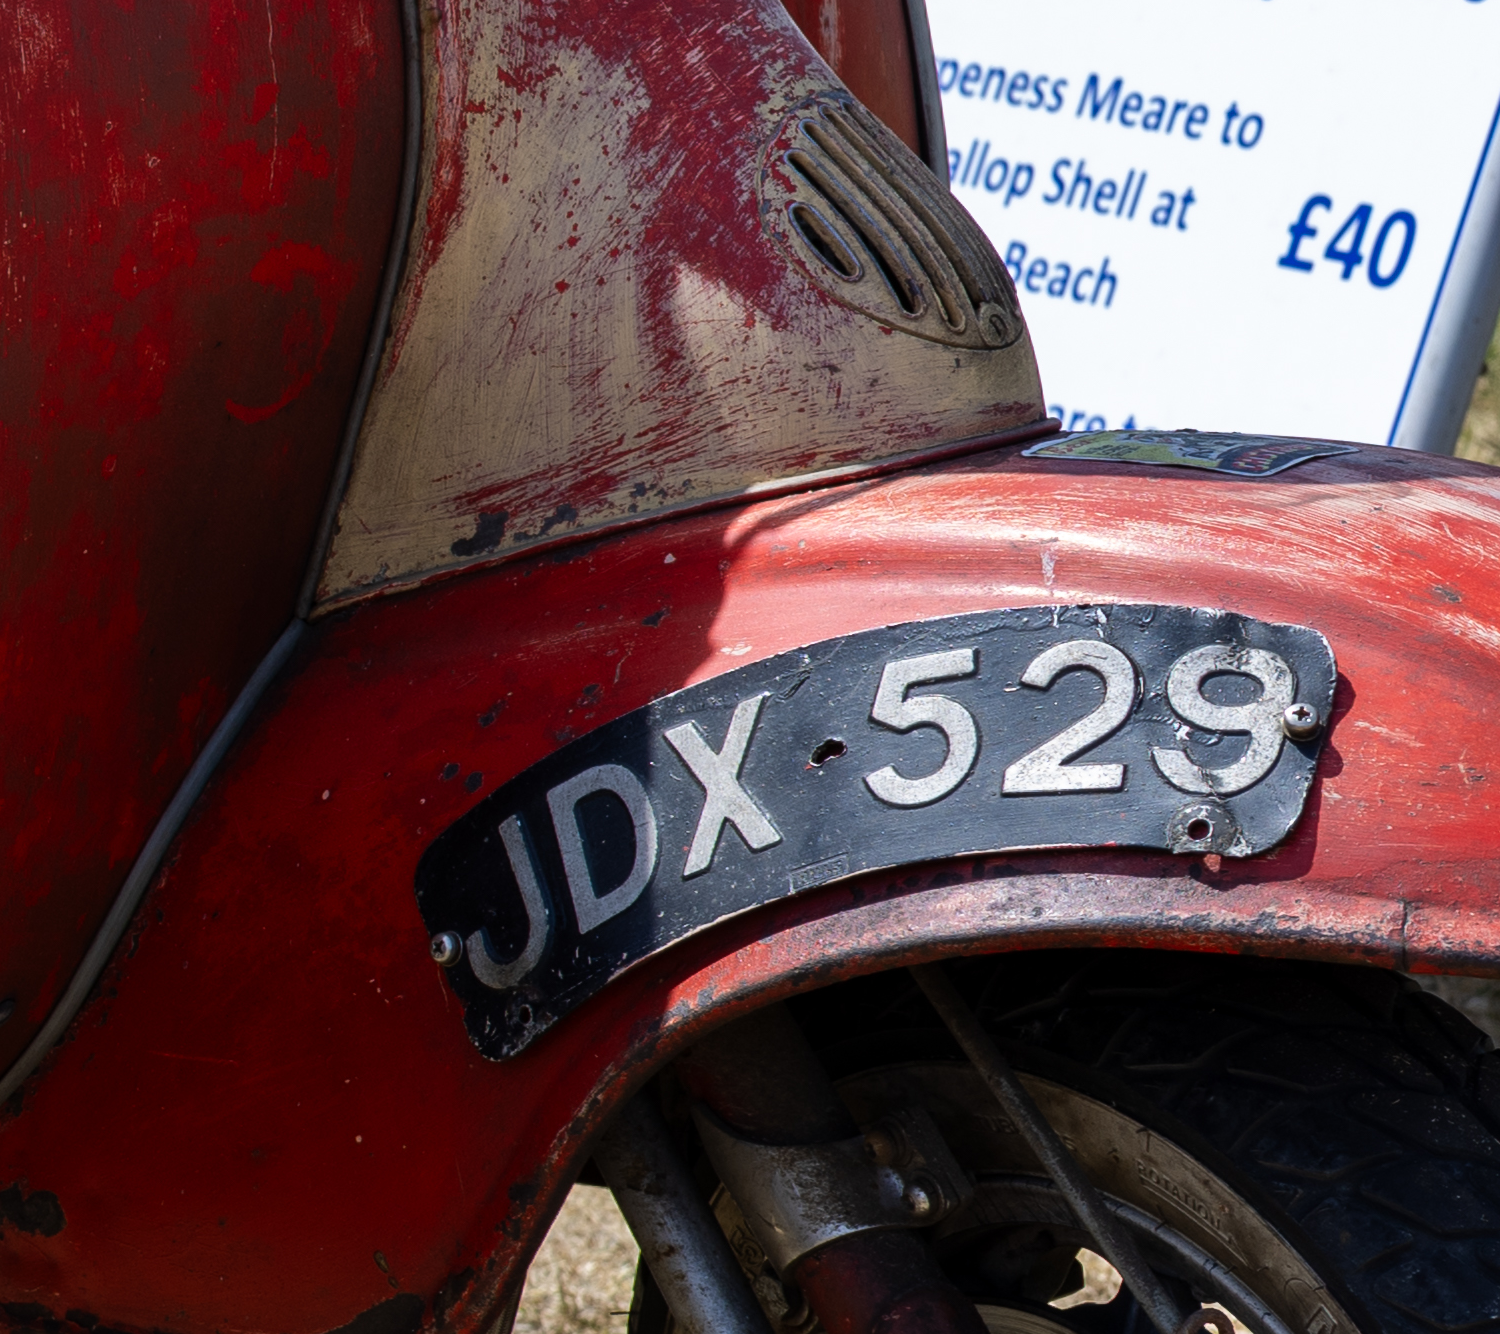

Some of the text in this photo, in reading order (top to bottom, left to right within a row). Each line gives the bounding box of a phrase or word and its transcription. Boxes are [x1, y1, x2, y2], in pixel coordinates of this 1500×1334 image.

[936, 55, 1266, 151] peness Meare to
[947, 137, 1199, 232] allop Shell at
[1002, 240, 1120, 308] Beach
[1276, 193, 1418, 291] £40
[465, 638, 1297, 990] JDX 529
